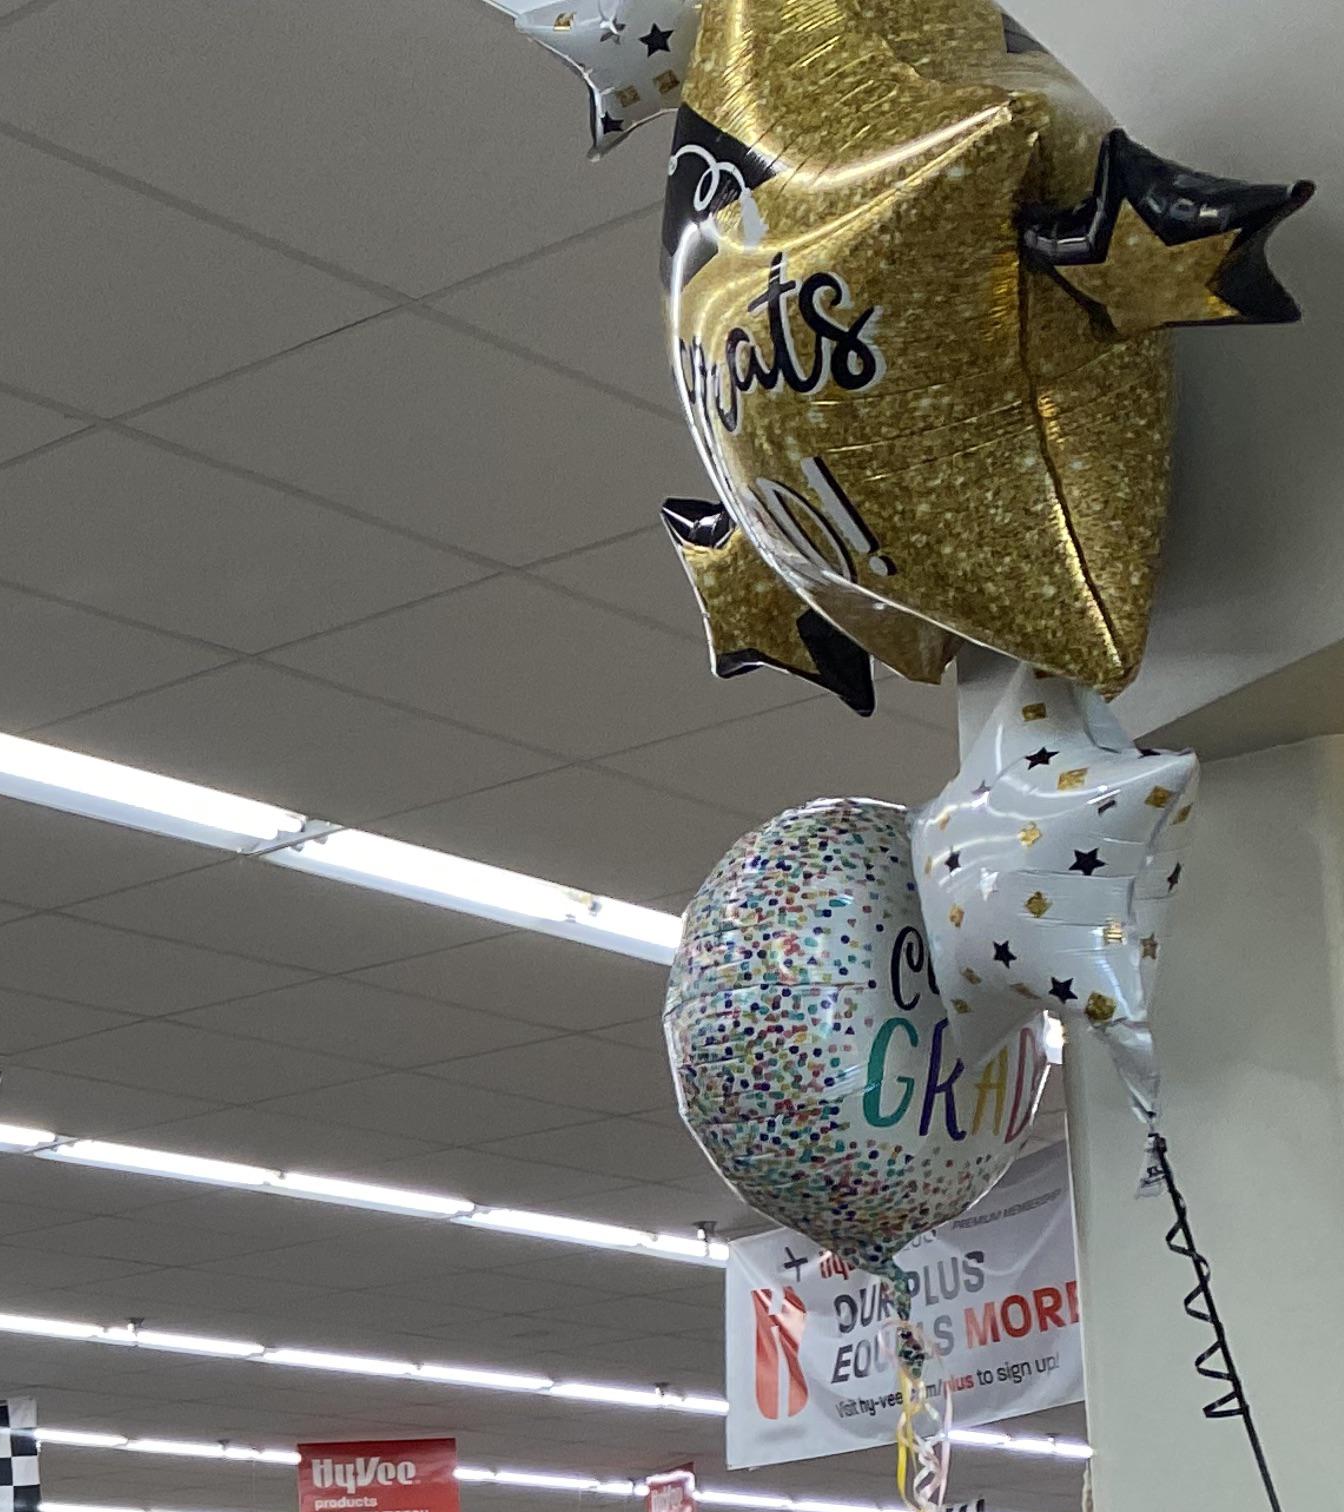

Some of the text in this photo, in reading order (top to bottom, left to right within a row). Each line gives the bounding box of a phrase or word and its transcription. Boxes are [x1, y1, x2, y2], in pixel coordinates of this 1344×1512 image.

[976, 1367, 993, 1386] to
[996, 1359, 1032, 1385] sign
[312, 1456, 417, 1494] HyVee
[314, 1496, 378, 1511] products
